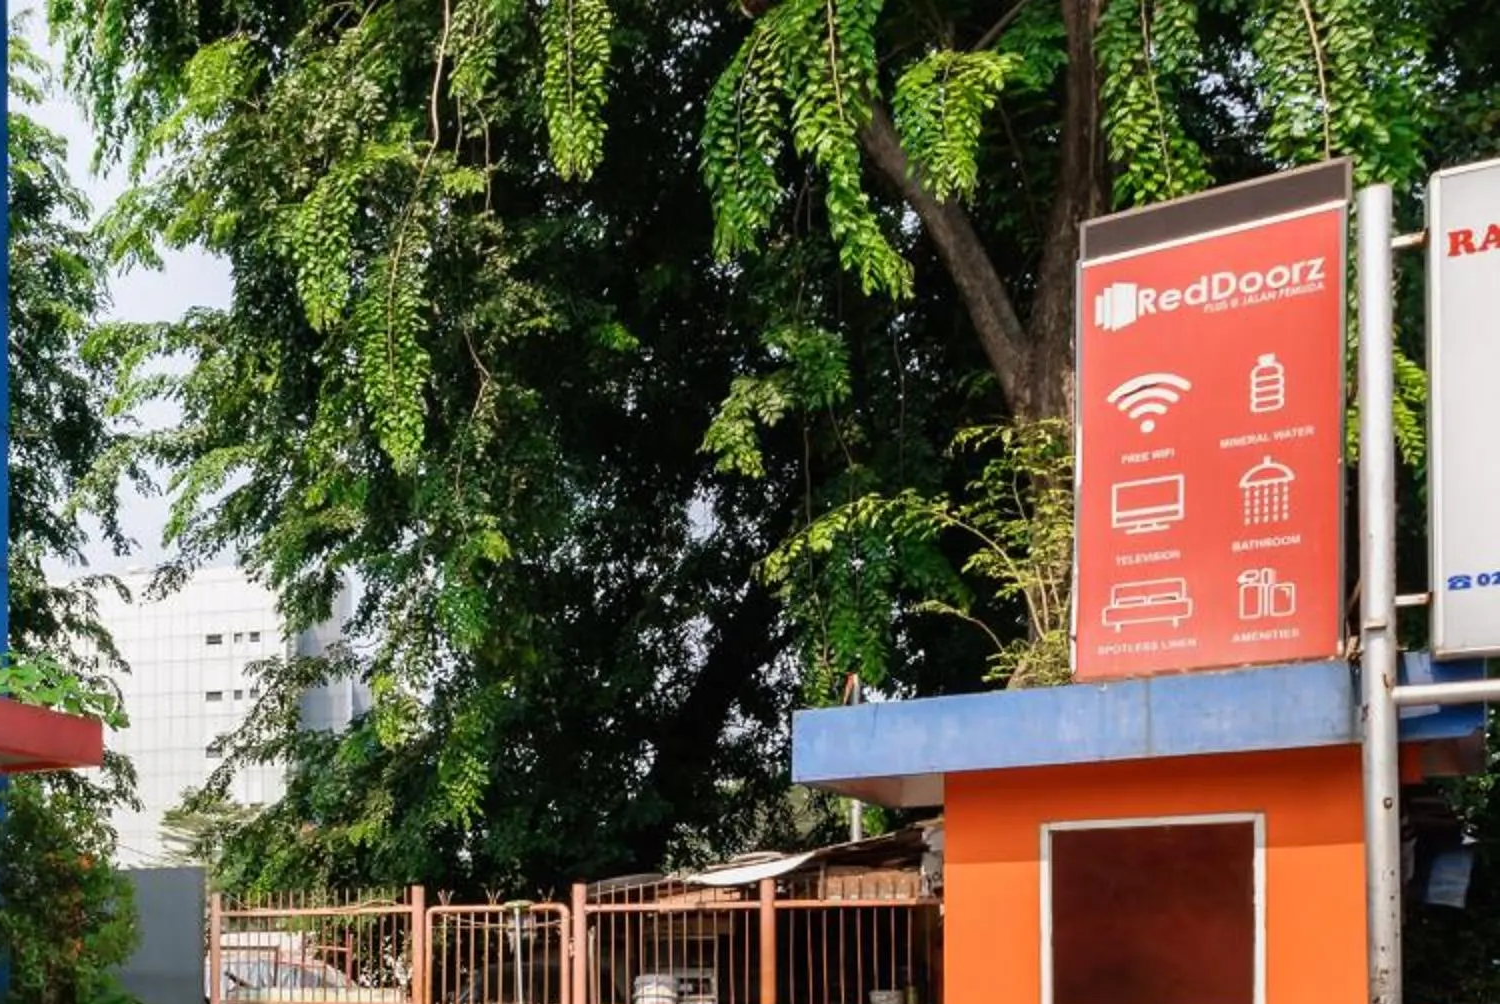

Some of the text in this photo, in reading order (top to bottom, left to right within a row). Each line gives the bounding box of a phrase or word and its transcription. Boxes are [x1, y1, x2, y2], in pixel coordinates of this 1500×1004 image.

[1137, 256, 1326, 316] RedDoorz
[1243, 290, 1276, 307] JALAN
[1219, 425, 1316, 449] MINERAL WATER
[1121, 447, 1176, 465] FREE WIFI
[1231, 534, 1302, 553] BATHROOM
[1115, 549, 1182, 567] TELEVISION
[1231, 627, 1301, 643] AMENITIES
[1097, 637, 1198, 656] SPOTLESS LINEN
